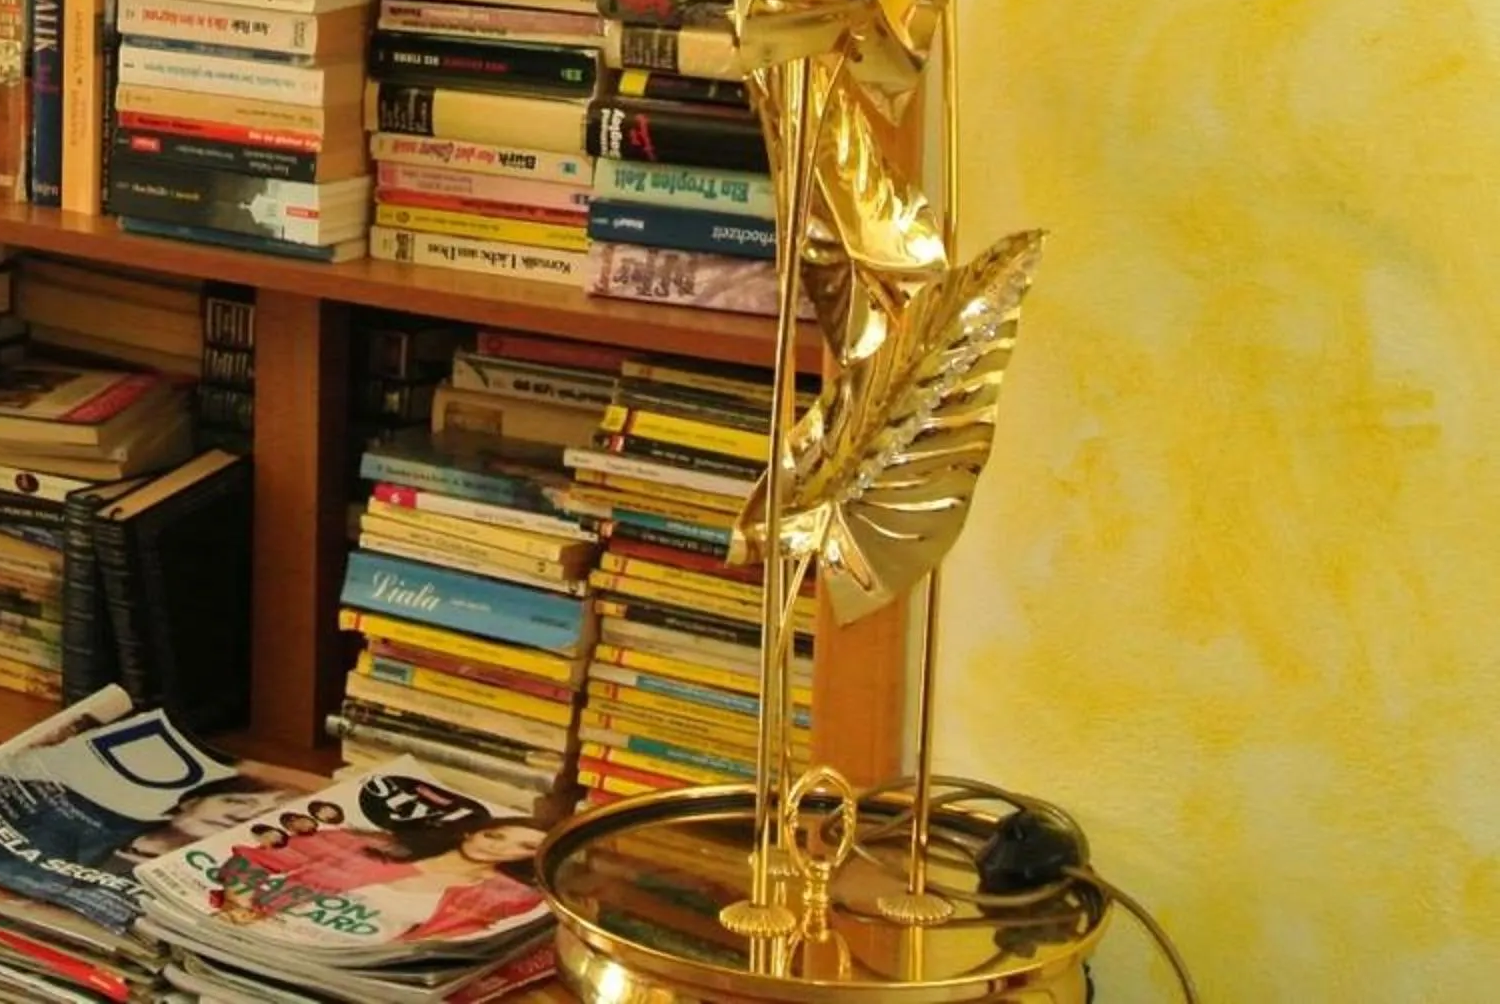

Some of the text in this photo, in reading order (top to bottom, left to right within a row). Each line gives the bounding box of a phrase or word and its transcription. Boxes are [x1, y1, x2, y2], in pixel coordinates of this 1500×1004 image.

[710, 226, 776, 247] rhochzeit
[86, 717, 205, 790] D
[40, 857, 151, 898] SEGRET
